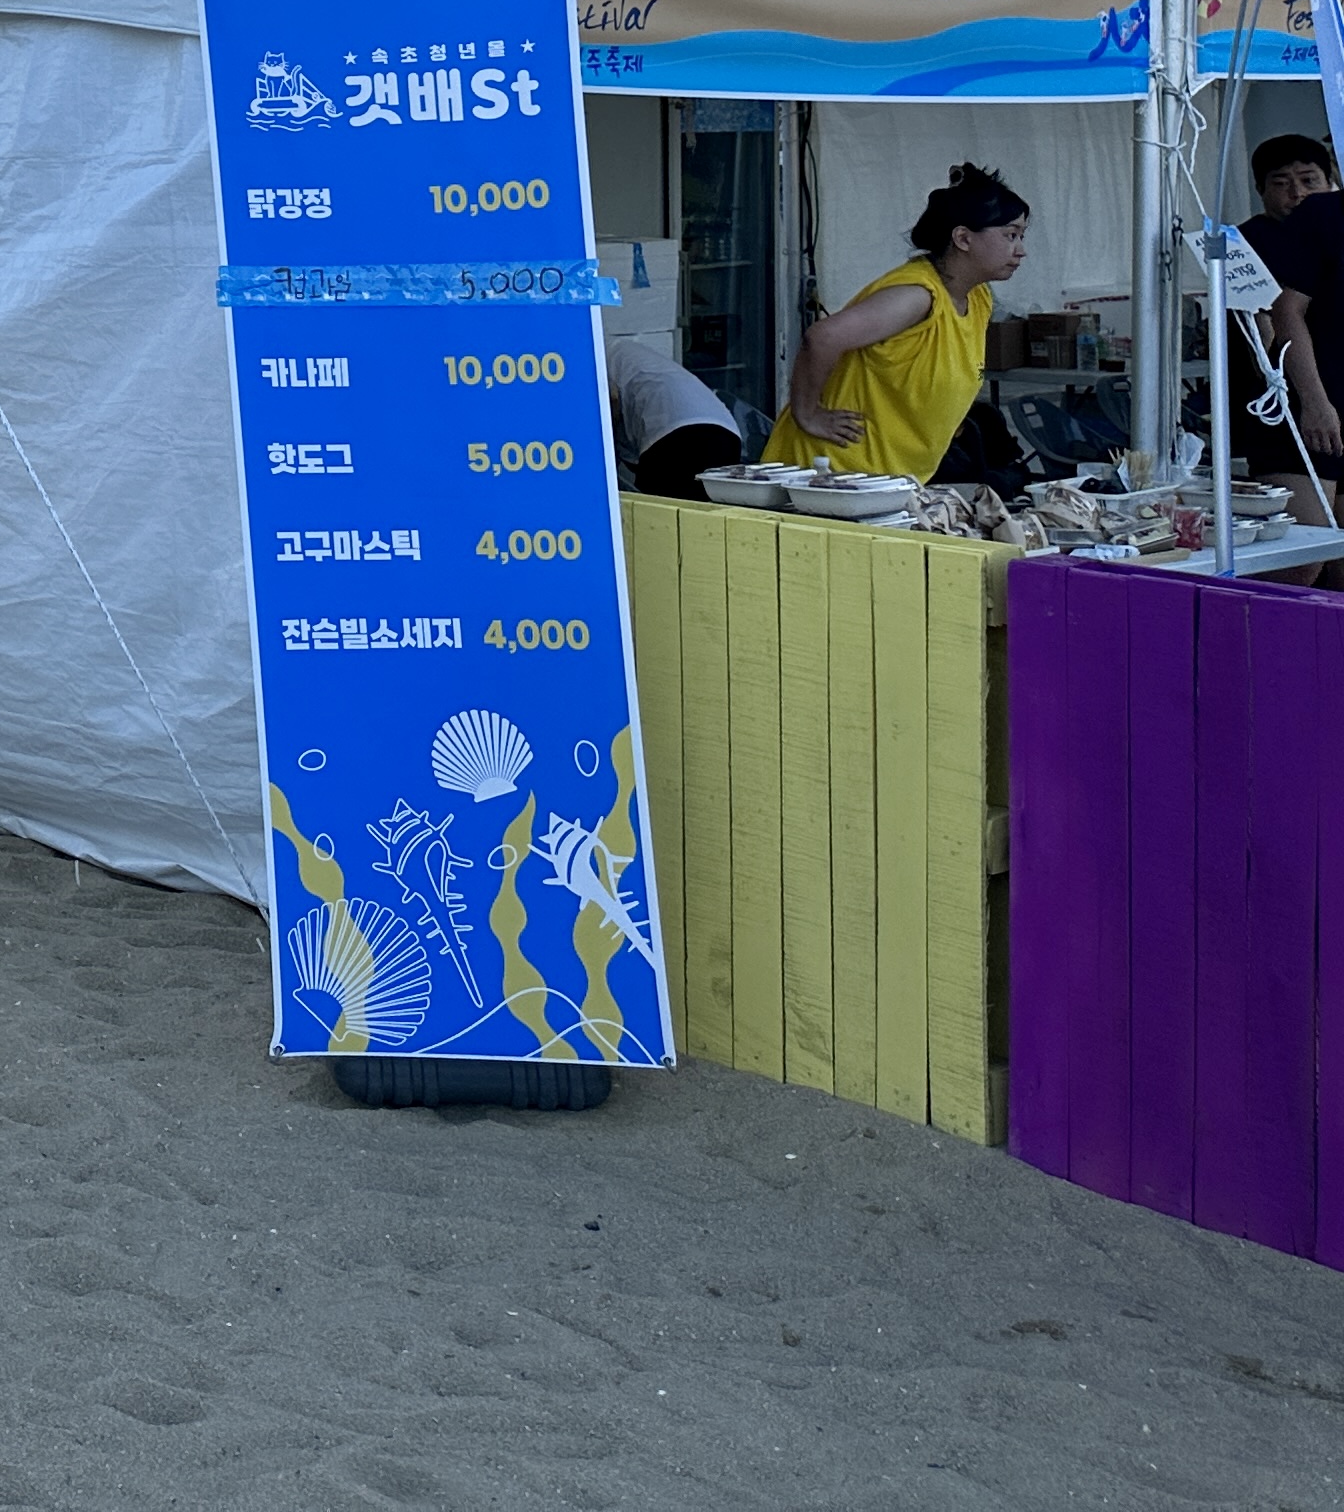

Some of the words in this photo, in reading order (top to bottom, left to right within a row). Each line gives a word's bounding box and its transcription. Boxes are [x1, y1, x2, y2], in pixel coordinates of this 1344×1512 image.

[371, 39, 506, 65] 속초청년몰
[344, 68, 541, 128] 갯배St
[246, 188, 333, 220] 닭강정
[429, 178, 550, 217] 10,000
[459, 266, 565, 300] 5,000
[261, 357, 350, 388] 카나페
[443, 352, 565, 390] 10,000
[267, 443, 354, 475] 핫도그
[467, 440, 574, 477] 5,000
[275, 530, 422, 562] 고구마스틱
[475, 529, 582, 565] 4,000
[281, 617, 463, 651] 잔슨빌소세지
[483, 619, 590, 655] 4,000
